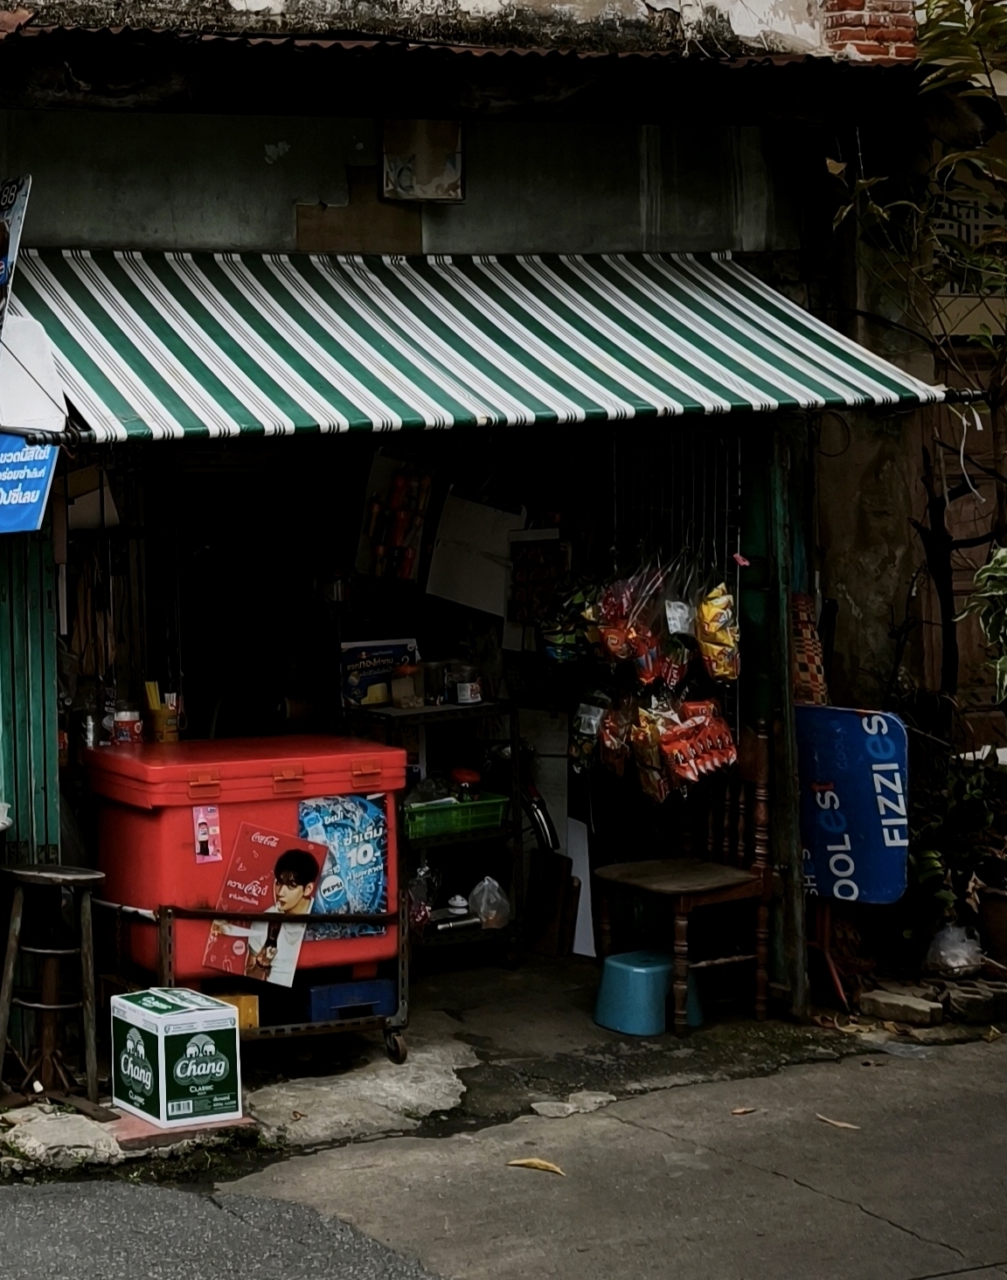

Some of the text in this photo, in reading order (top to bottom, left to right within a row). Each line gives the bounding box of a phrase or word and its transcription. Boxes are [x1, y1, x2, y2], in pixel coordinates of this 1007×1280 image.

[322, 881, 343, 895] PEPSI
[120, 1054, 152, 1090] Chang
[175, 1059, 226, 1078] Chang
